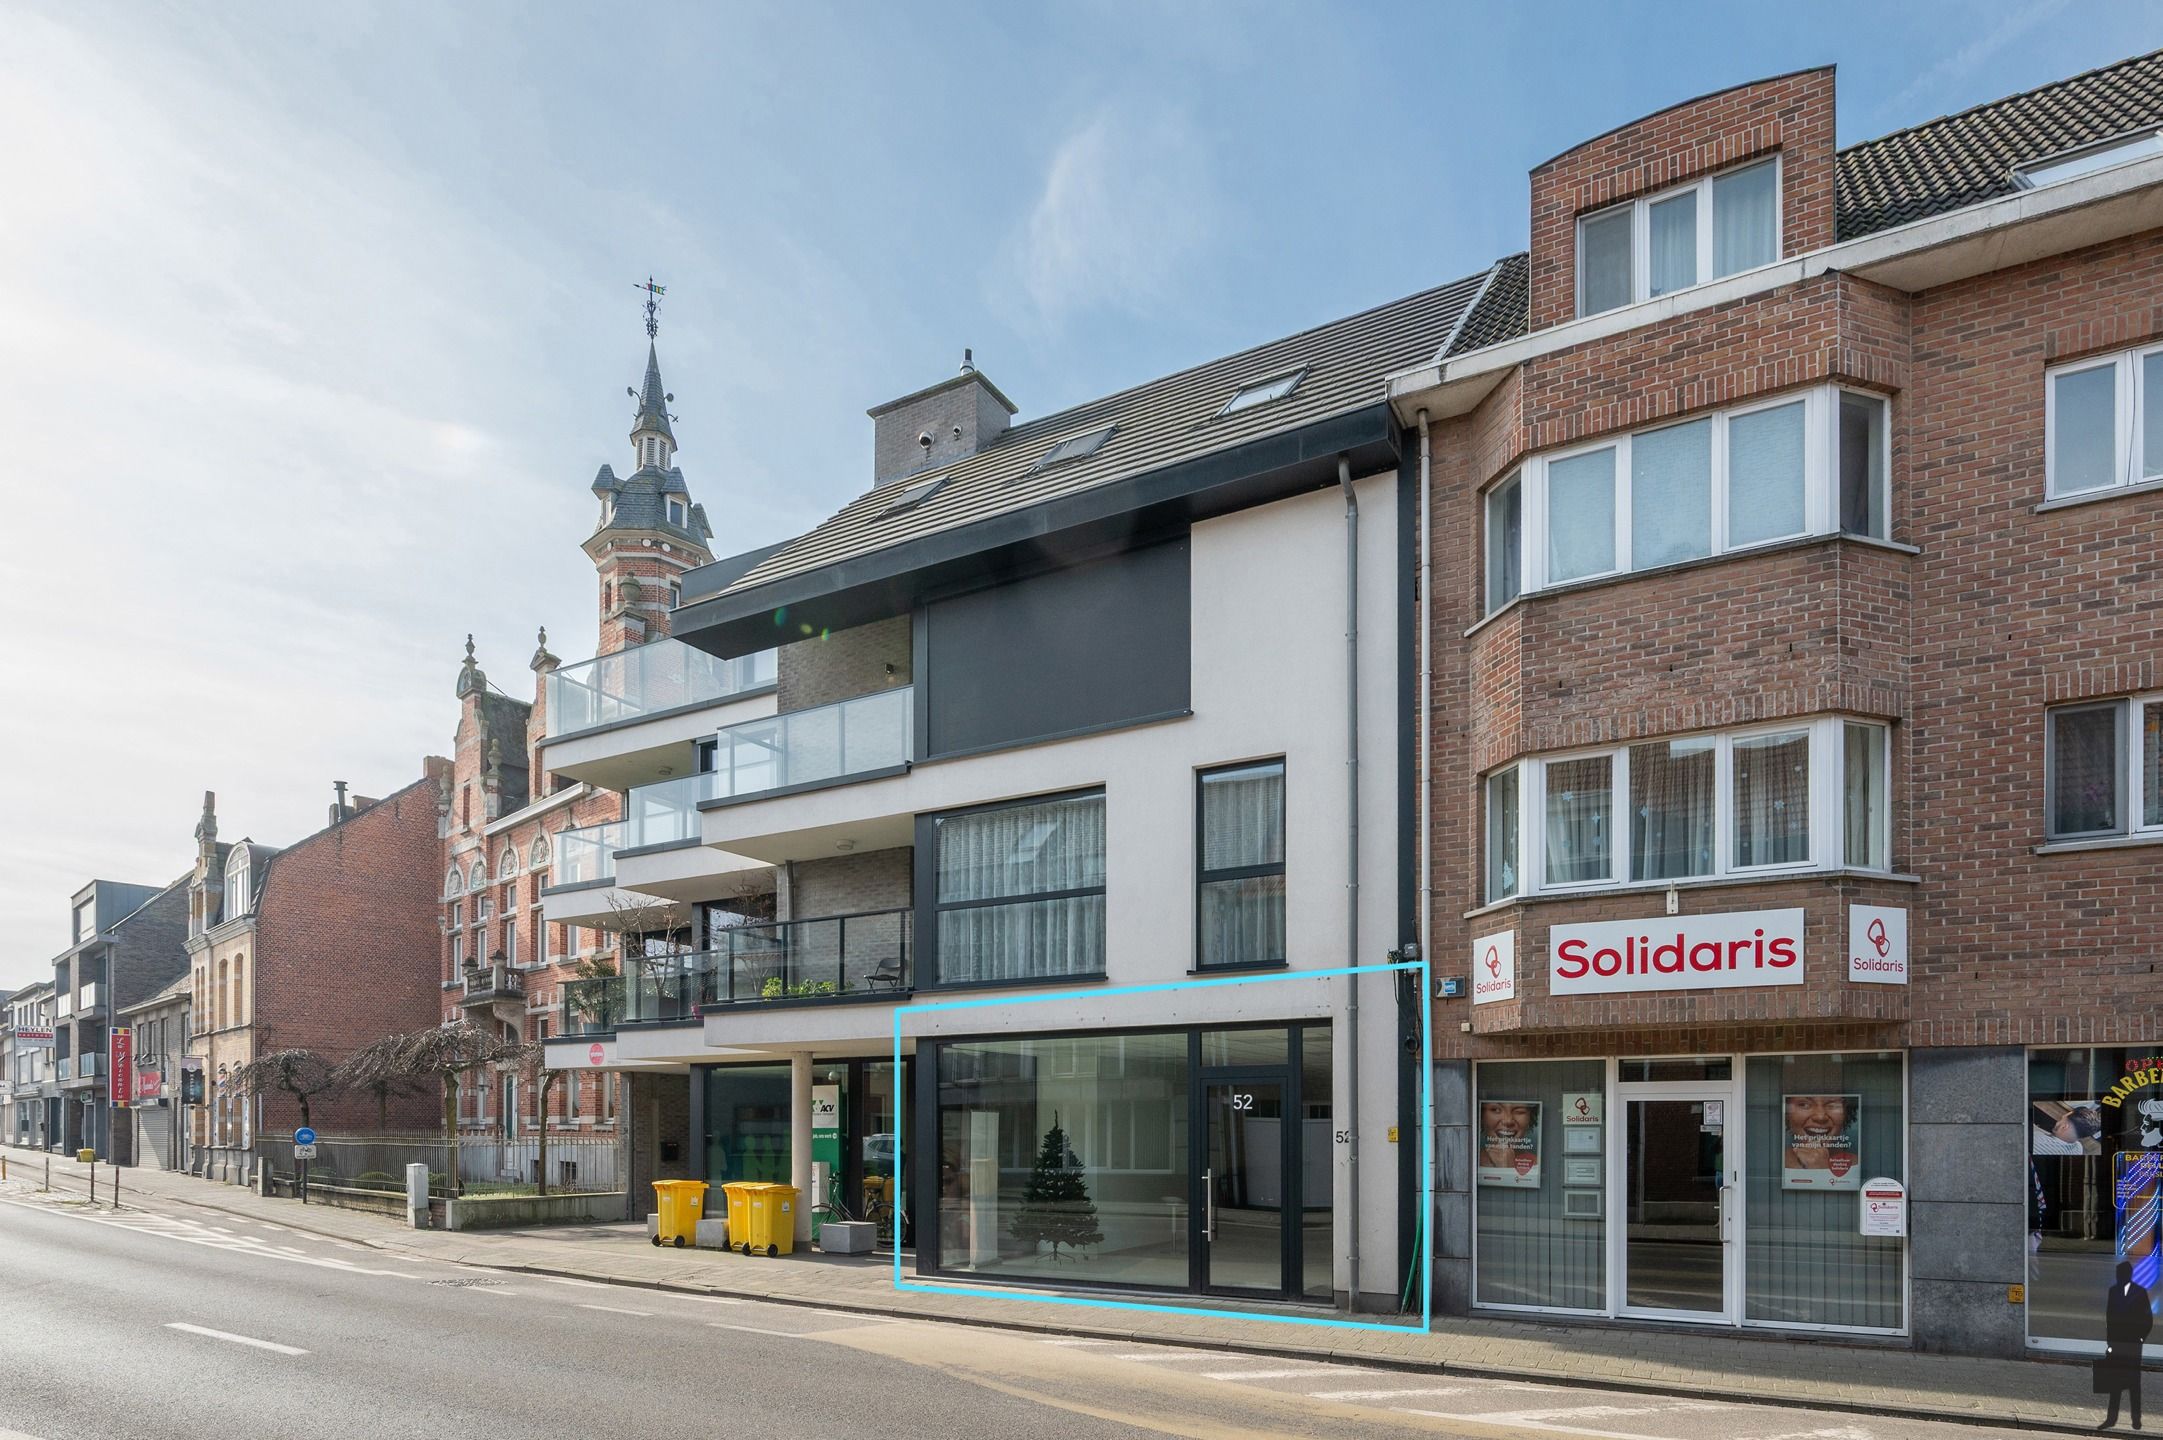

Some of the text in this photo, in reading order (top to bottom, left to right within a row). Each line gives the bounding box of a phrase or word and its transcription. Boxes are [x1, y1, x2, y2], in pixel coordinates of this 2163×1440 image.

[1556, 929, 1797, 979] Solidaris
[1853, 957, 1904, 972] Solidaris
[1476, 979, 1512, 994] Solidaris
[2101, 1067, 2163, 1109] BARBE
[820, 1104, 834, 1112] ACV
[1233, 1094, 1253, 1110] 52
[1808, 1134, 1850, 1143] prijskaartje
